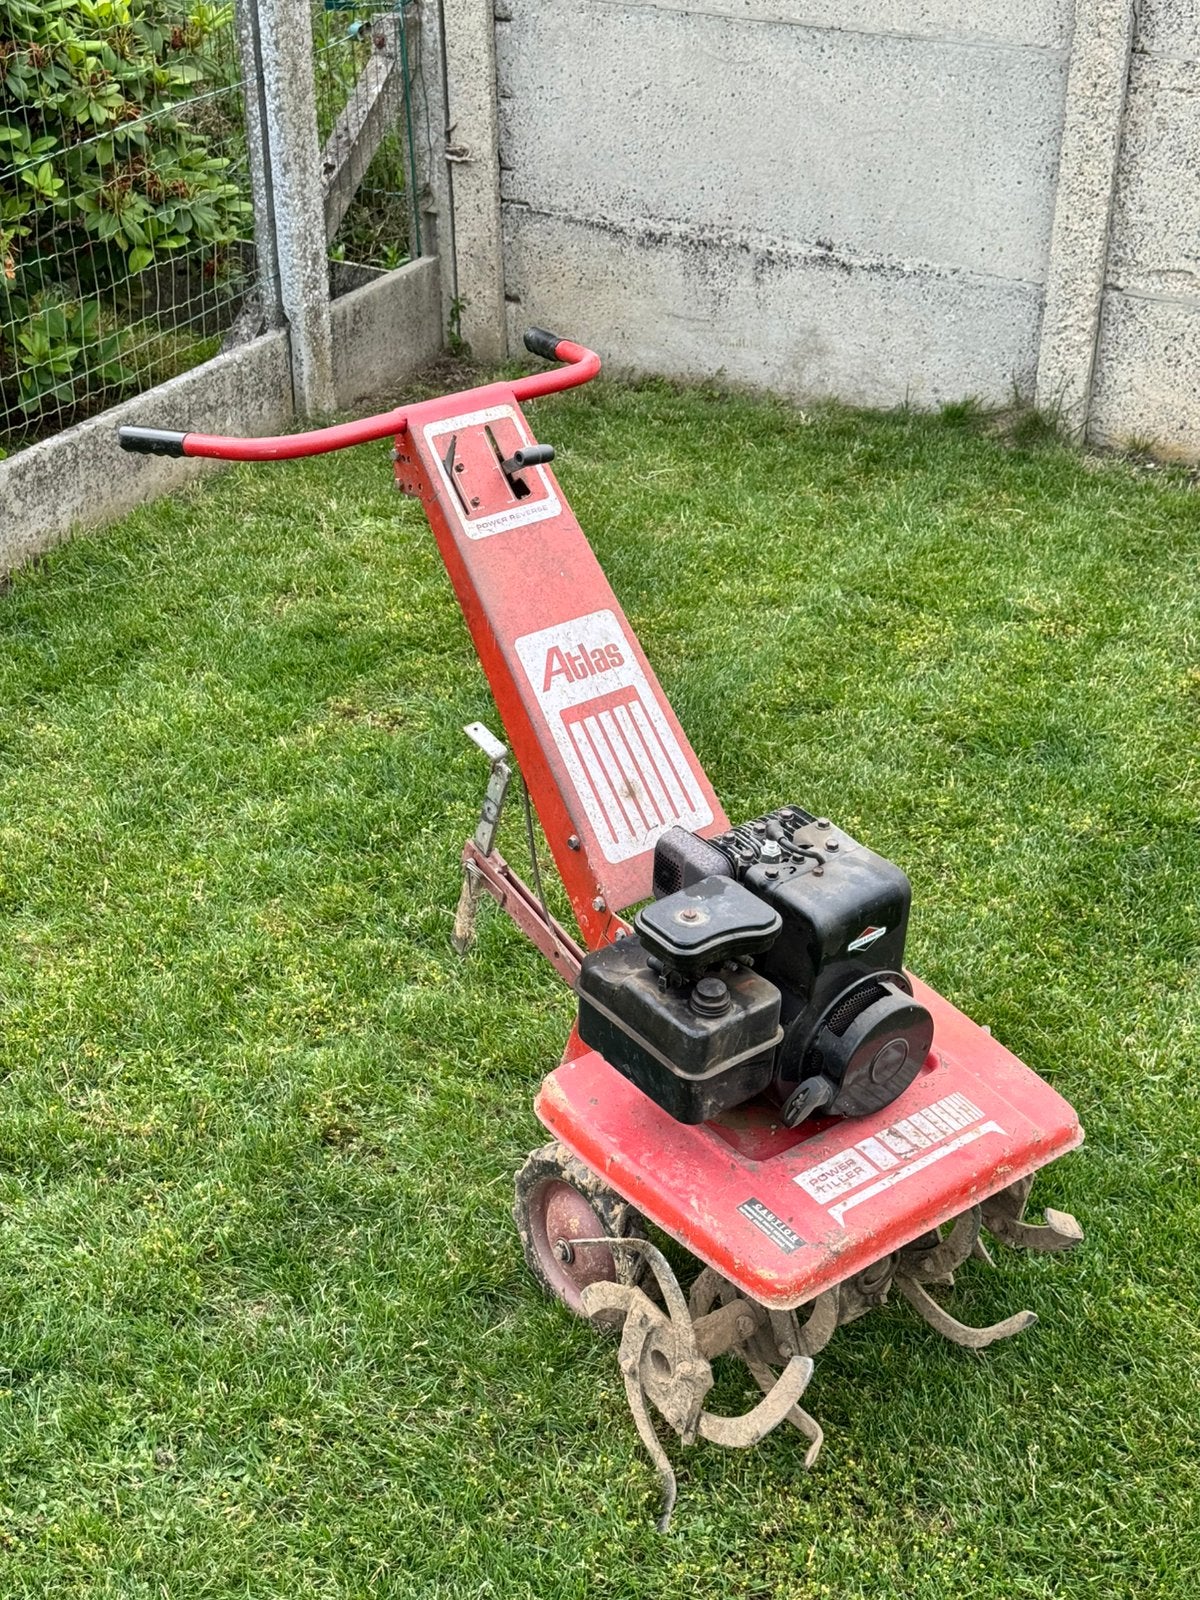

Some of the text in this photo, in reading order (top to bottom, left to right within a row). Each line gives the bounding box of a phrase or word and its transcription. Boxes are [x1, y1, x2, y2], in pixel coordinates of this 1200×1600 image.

[476, 515, 508, 530] POWER
[543, 642, 625, 693] Atlas
[809, 1158, 857, 1187] POWER
[815, 1166, 865, 1193] TILLER
[755, 1203, 800, 1241] CAUTION
